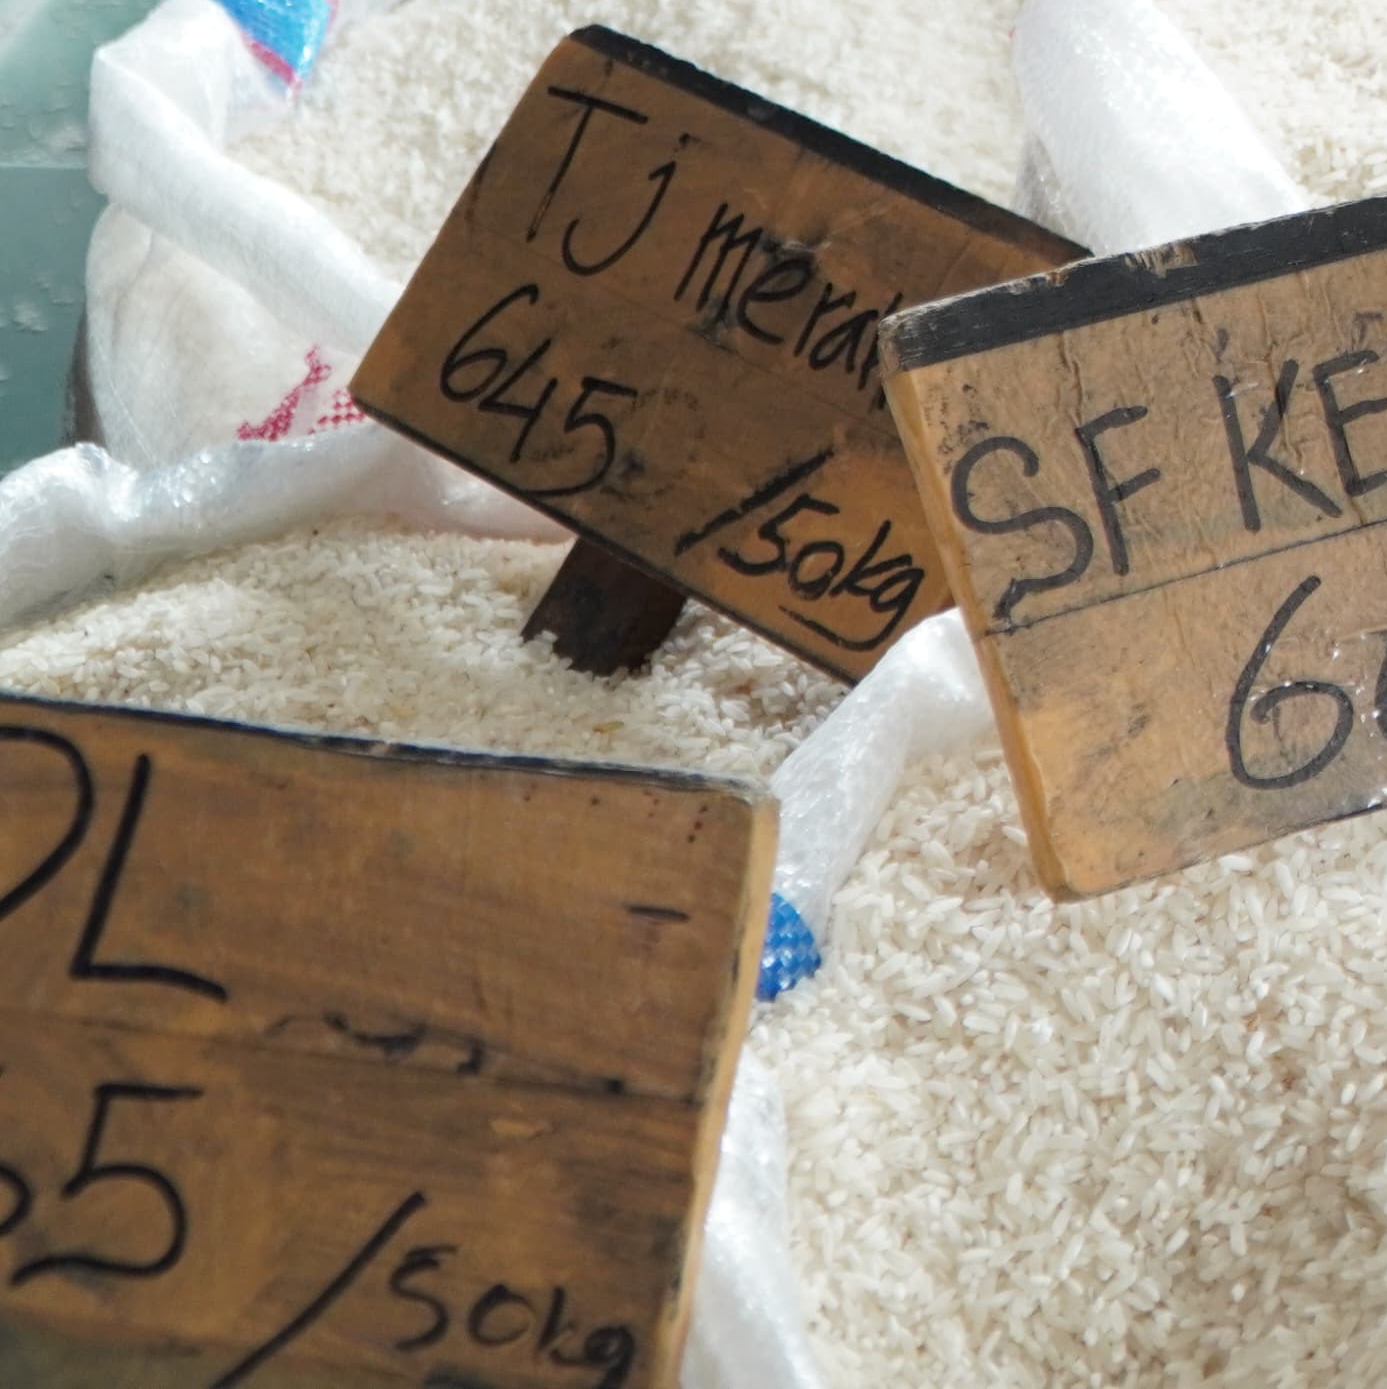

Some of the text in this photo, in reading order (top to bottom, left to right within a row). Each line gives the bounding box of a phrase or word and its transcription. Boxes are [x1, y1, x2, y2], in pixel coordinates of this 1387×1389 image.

[439, 283, 640, 497] 645
[948, 405, 1164, 636] SF
[0, 1081, 205, 1287] 5
